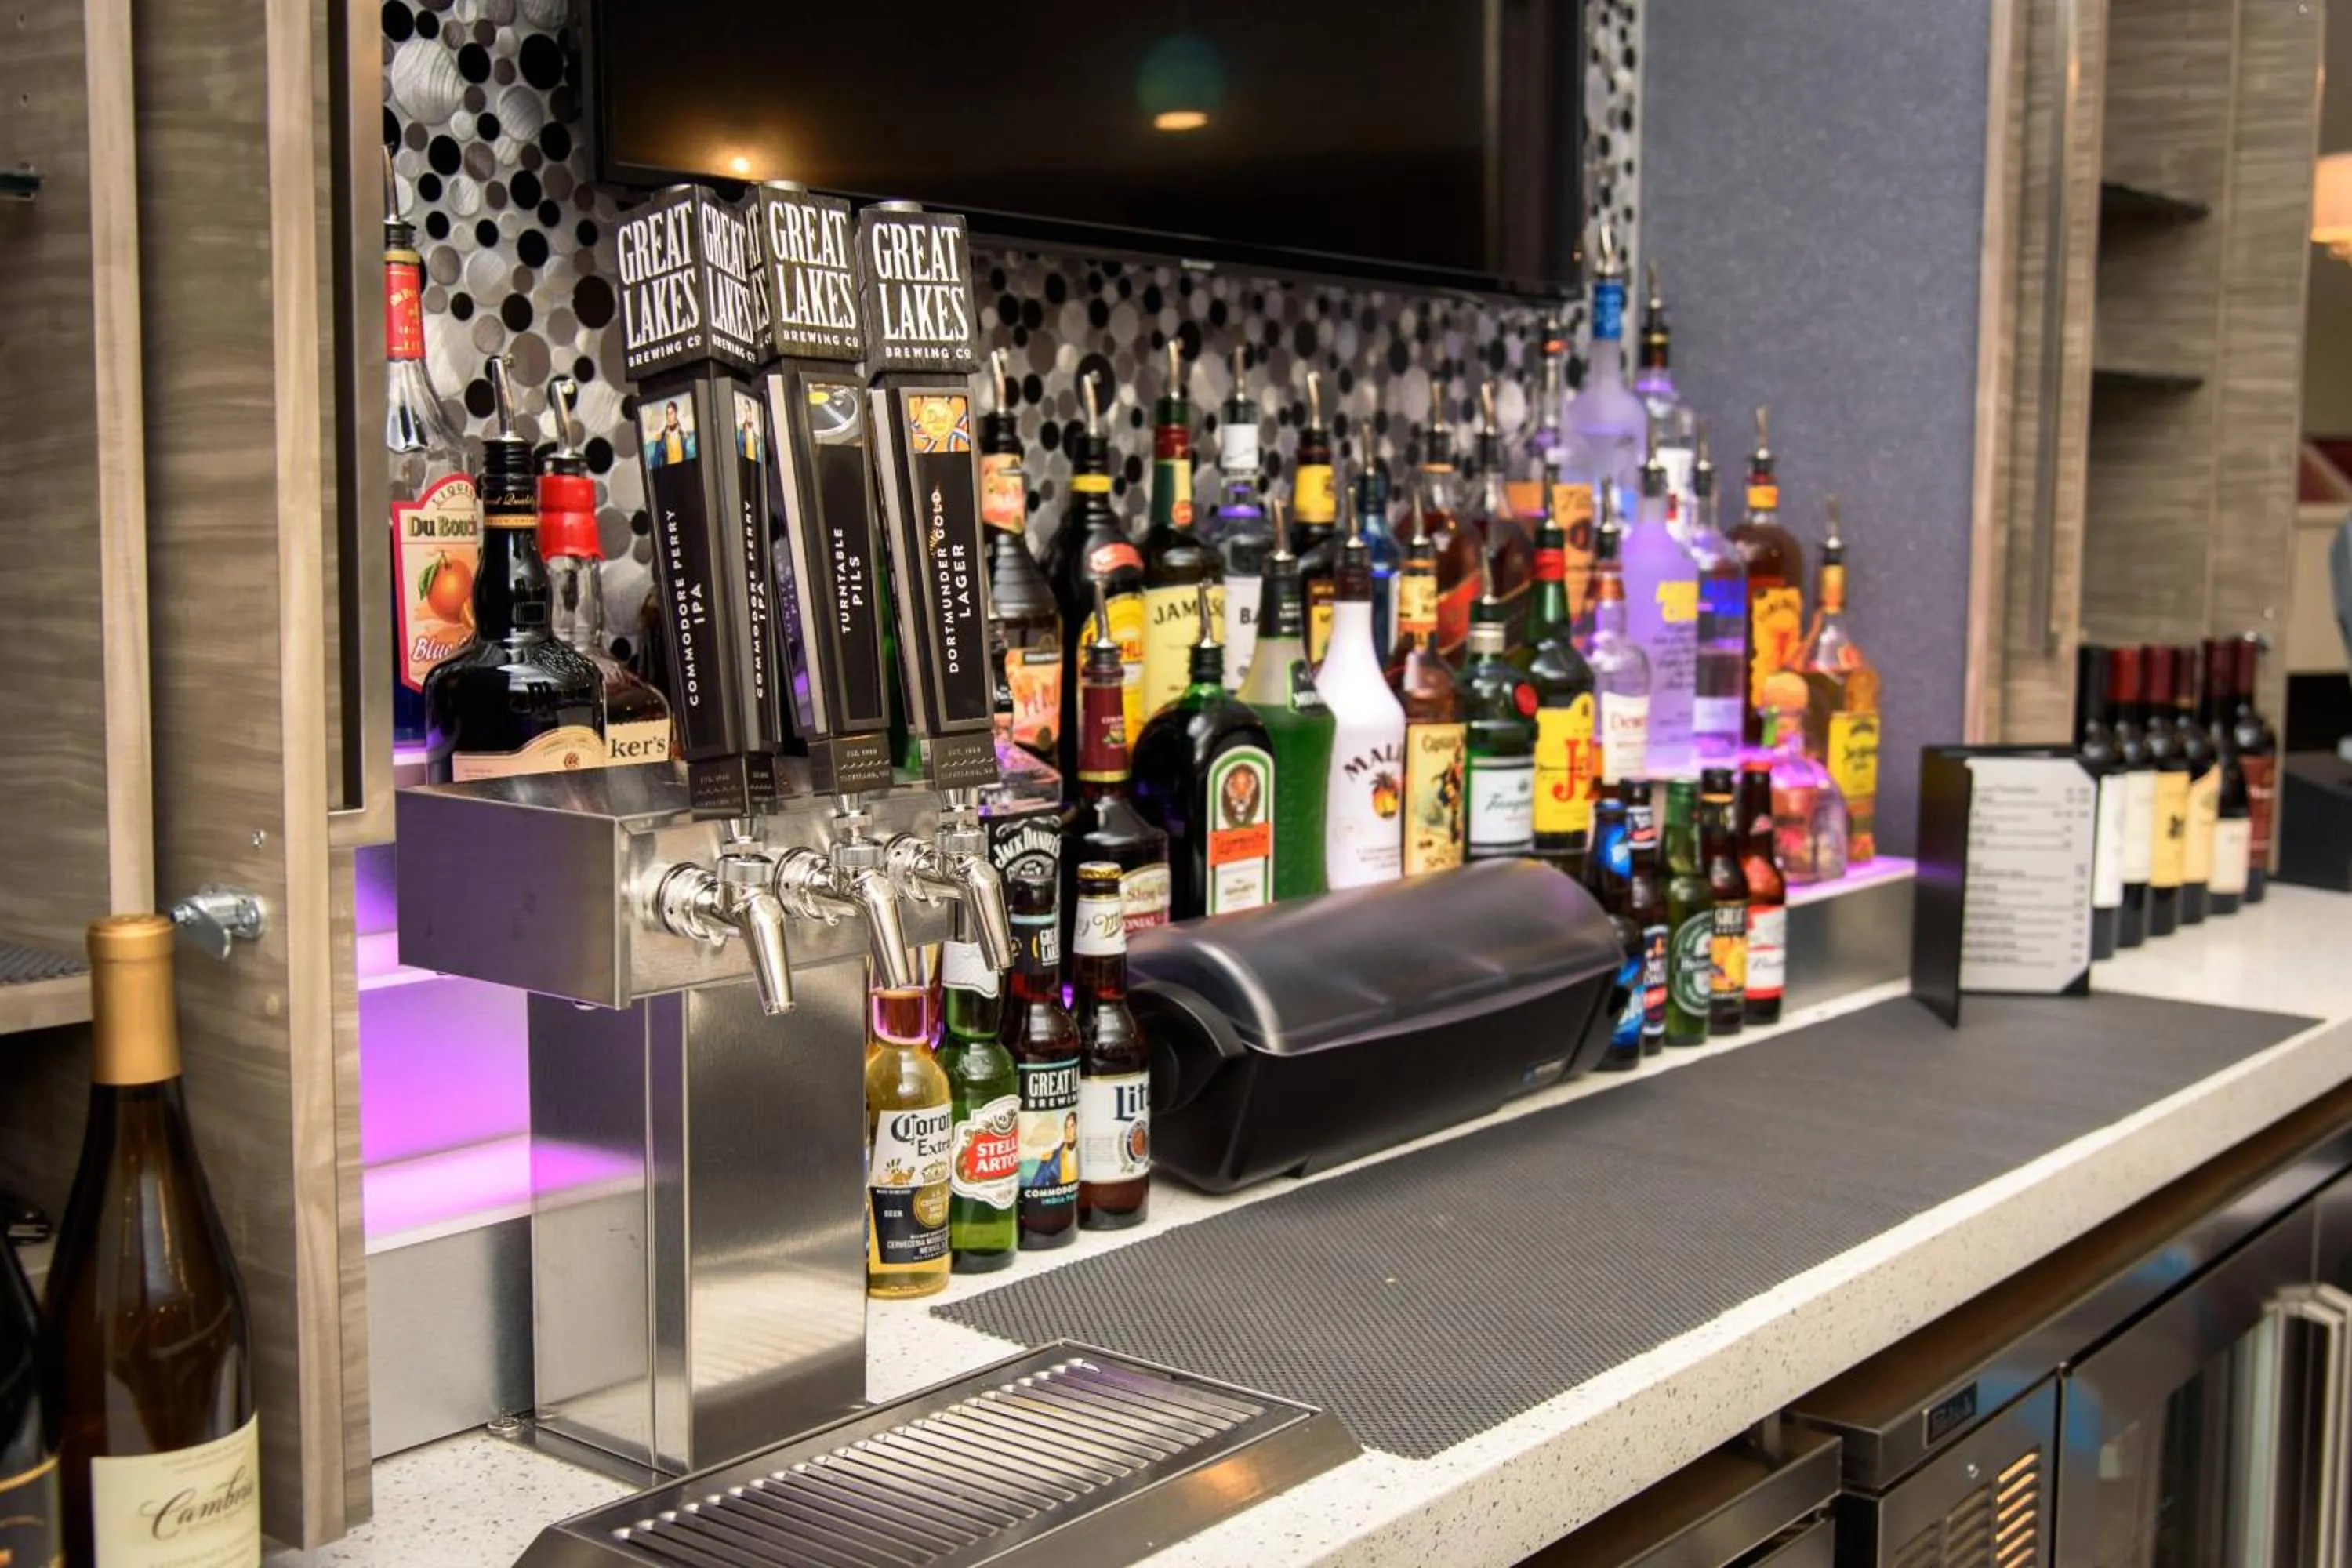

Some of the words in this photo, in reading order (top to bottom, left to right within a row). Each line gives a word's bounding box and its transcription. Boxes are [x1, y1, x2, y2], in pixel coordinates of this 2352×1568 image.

[617, 201, 693, 285] GREAT
[702, 201, 747, 282] GREAT
[768, 200, 848, 269] GREAT
[872, 223, 960, 282] GREAT
[623, 268, 699, 350] LAKES
[707, 267, 753, 344] LAKES
[775, 263, 857, 329] LAKES
[879, 283, 969, 341] LAKES
[629, 343, 683, 368] BREWING
[712, 333, 745, 359] BREWING
[783, 330, 840, 347] BREWING
[885, 347, 949, 360] BREWING
[407, 515, 436, 537] Du
[666, 509, 684, 570] PERRY
[744, 500, 756, 561] PERRY
[931, 489, 946, 540] GOLD
[693, 583, 706, 625] IPA
[757, 581, 766, 620] IPA
[833, 527, 851, 634] TURNTABLE
[850, 555, 863, 606] PILS
[952, 543, 971, 619] LAGER
[749, 570, 764, 699] COMMODORE
[937, 546, 960, 674] DORTMUNDER
[673, 575, 700, 706] COMMODORE
[609, 736, 666, 759] ker's
[1029, 1069, 1070, 1097] GREAT
[1112, 1083, 1150, 1122] Lit
[891, 1113, 950, 1146] Coro
[977, 1136, 1017, 1157] STELL
[976, 1153, 1017, 1173] ARTO
